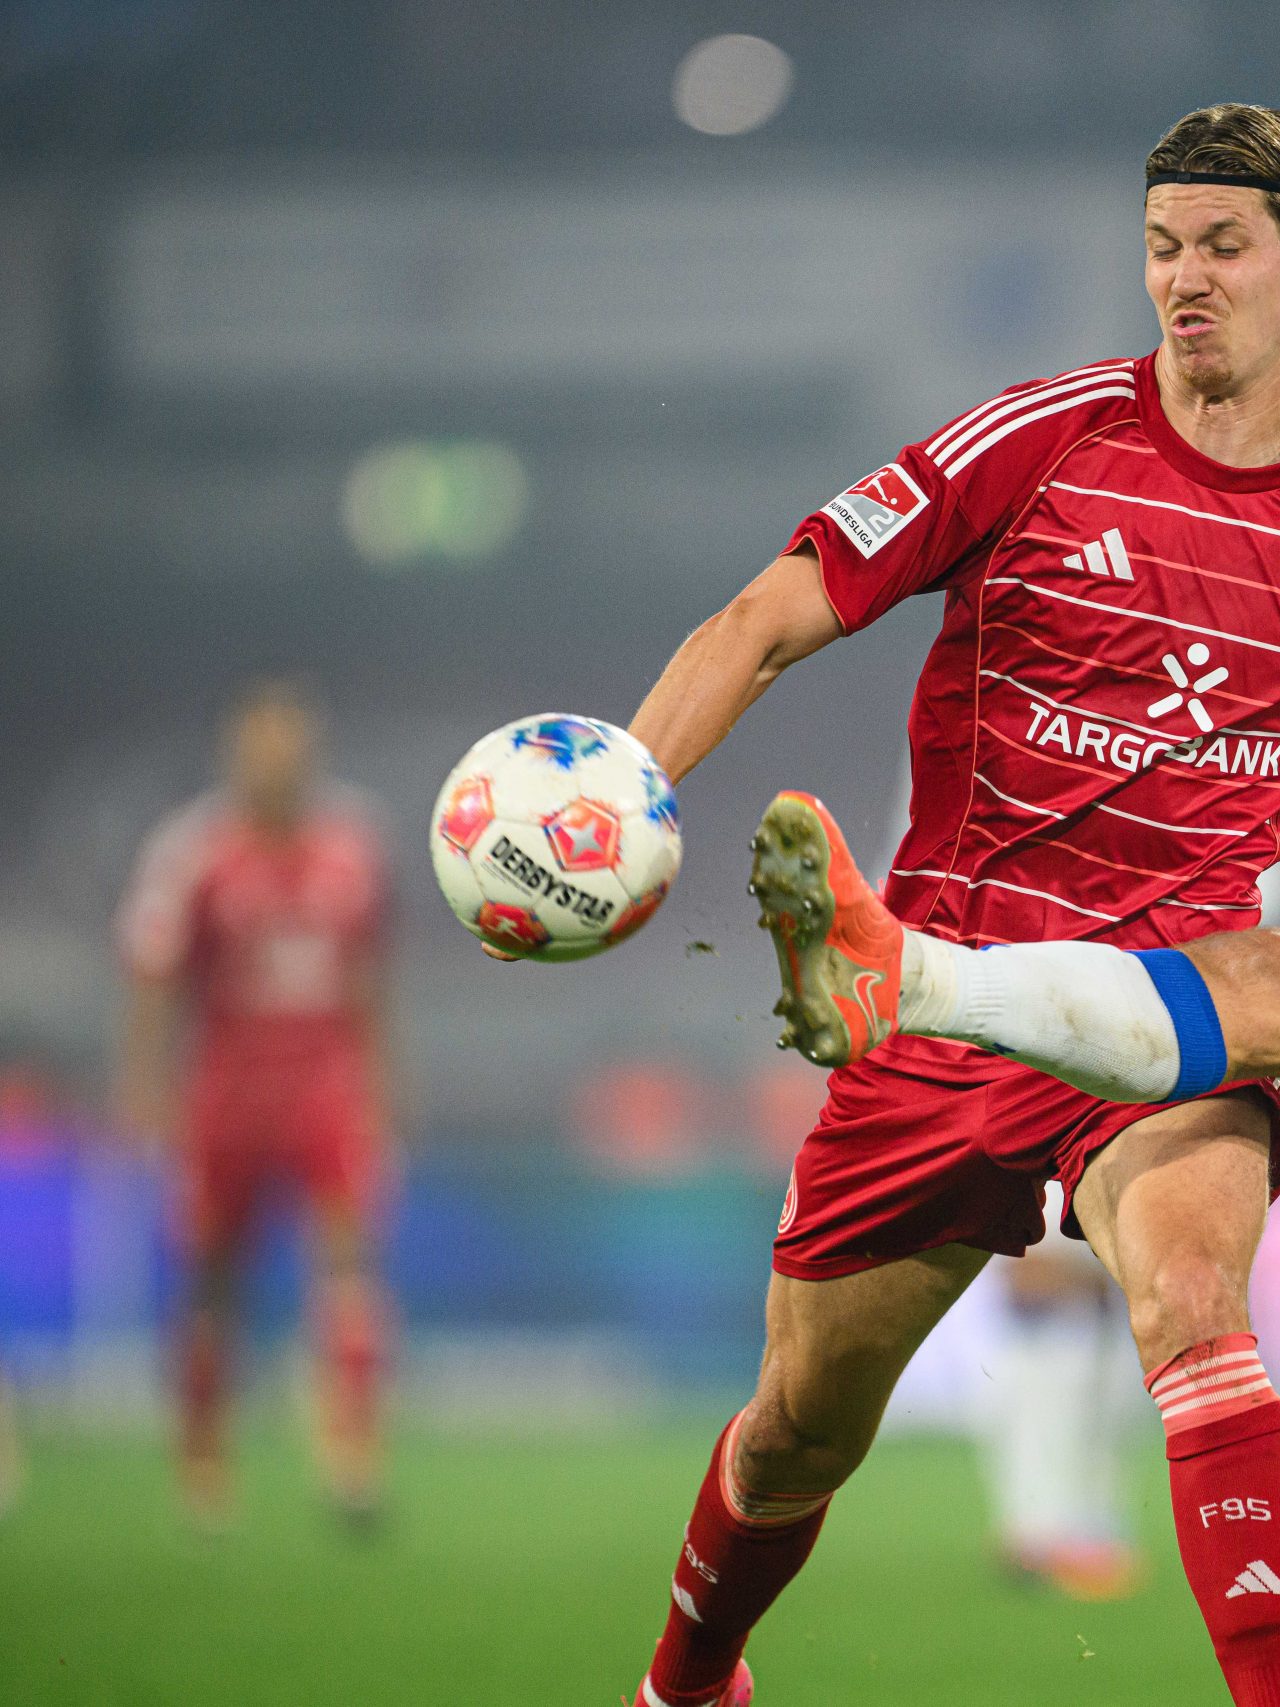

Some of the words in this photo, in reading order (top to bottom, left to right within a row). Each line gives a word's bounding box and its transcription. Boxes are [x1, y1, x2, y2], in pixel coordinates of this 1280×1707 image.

[828, 501, 873, 549] BUNDESLIGA
[867, 507, 896, 534] 2
[490, 834, 616, 924] DERBYSTAR
[1199, 1497, 1272, 1529] F95
[683, 1521, 719, 1584] 95
